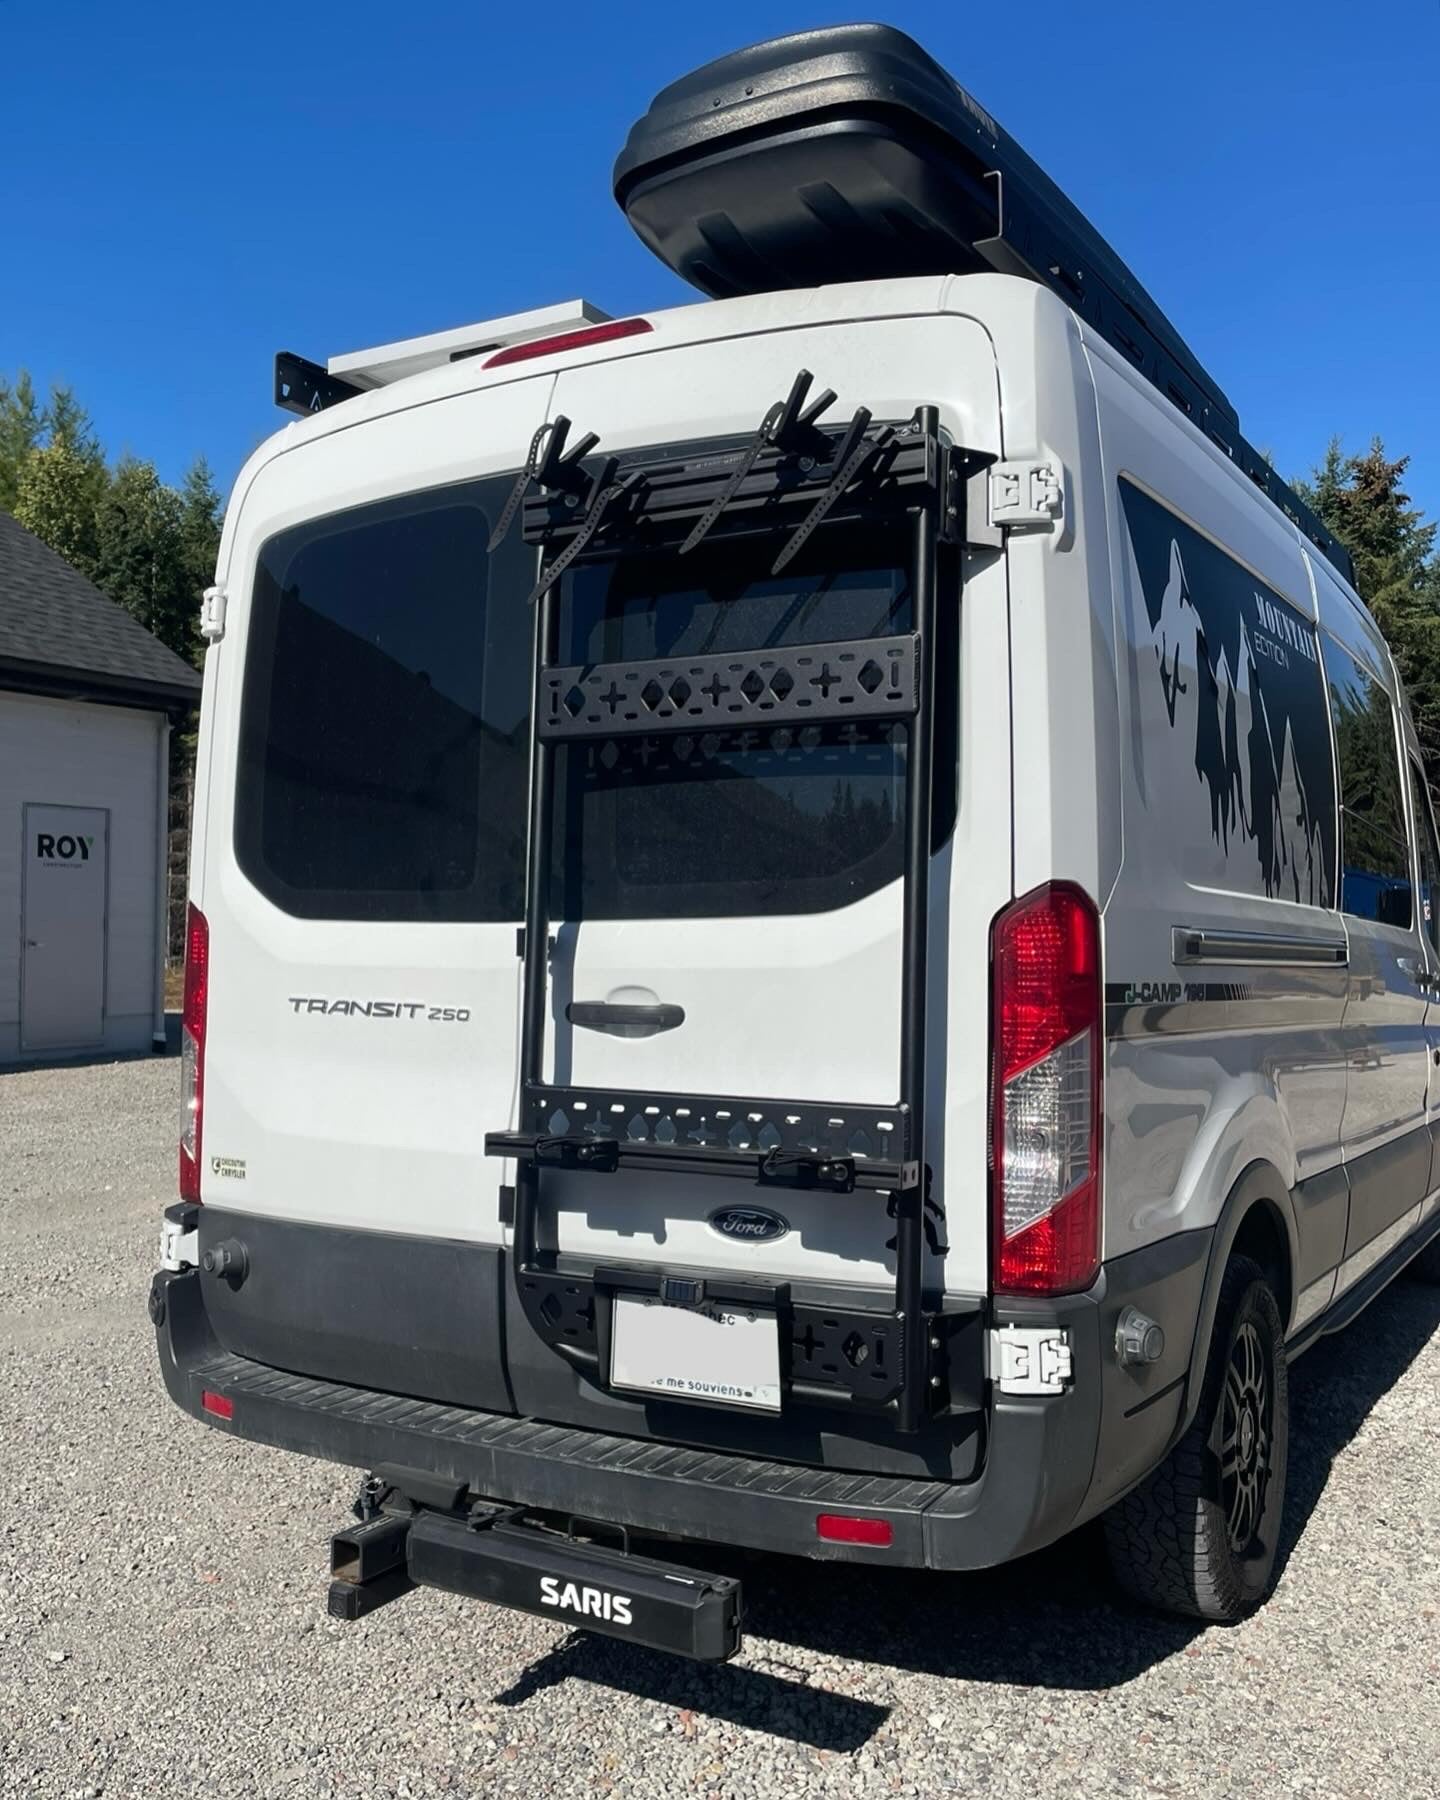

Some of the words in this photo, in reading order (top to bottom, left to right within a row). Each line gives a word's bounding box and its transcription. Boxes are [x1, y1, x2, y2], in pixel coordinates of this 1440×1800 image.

[1253, 591, 1318, 664] MOUNTAIN
[1253, 631, 1290, 670] EDITION
[37, 833, 95, 860] ROY
[288, 997, 425, 1019] TRANSIT
[427, 1007, 471, 1022] 250
[221, 1168, 246, 1180] CHRYSLER
[722, 1212, 768, 1235] Ford
[666, 1377, 685, 1388] me
[688, 1379, 743, 1397] souviens
[540, 1576, 633, 1625] SARIS
